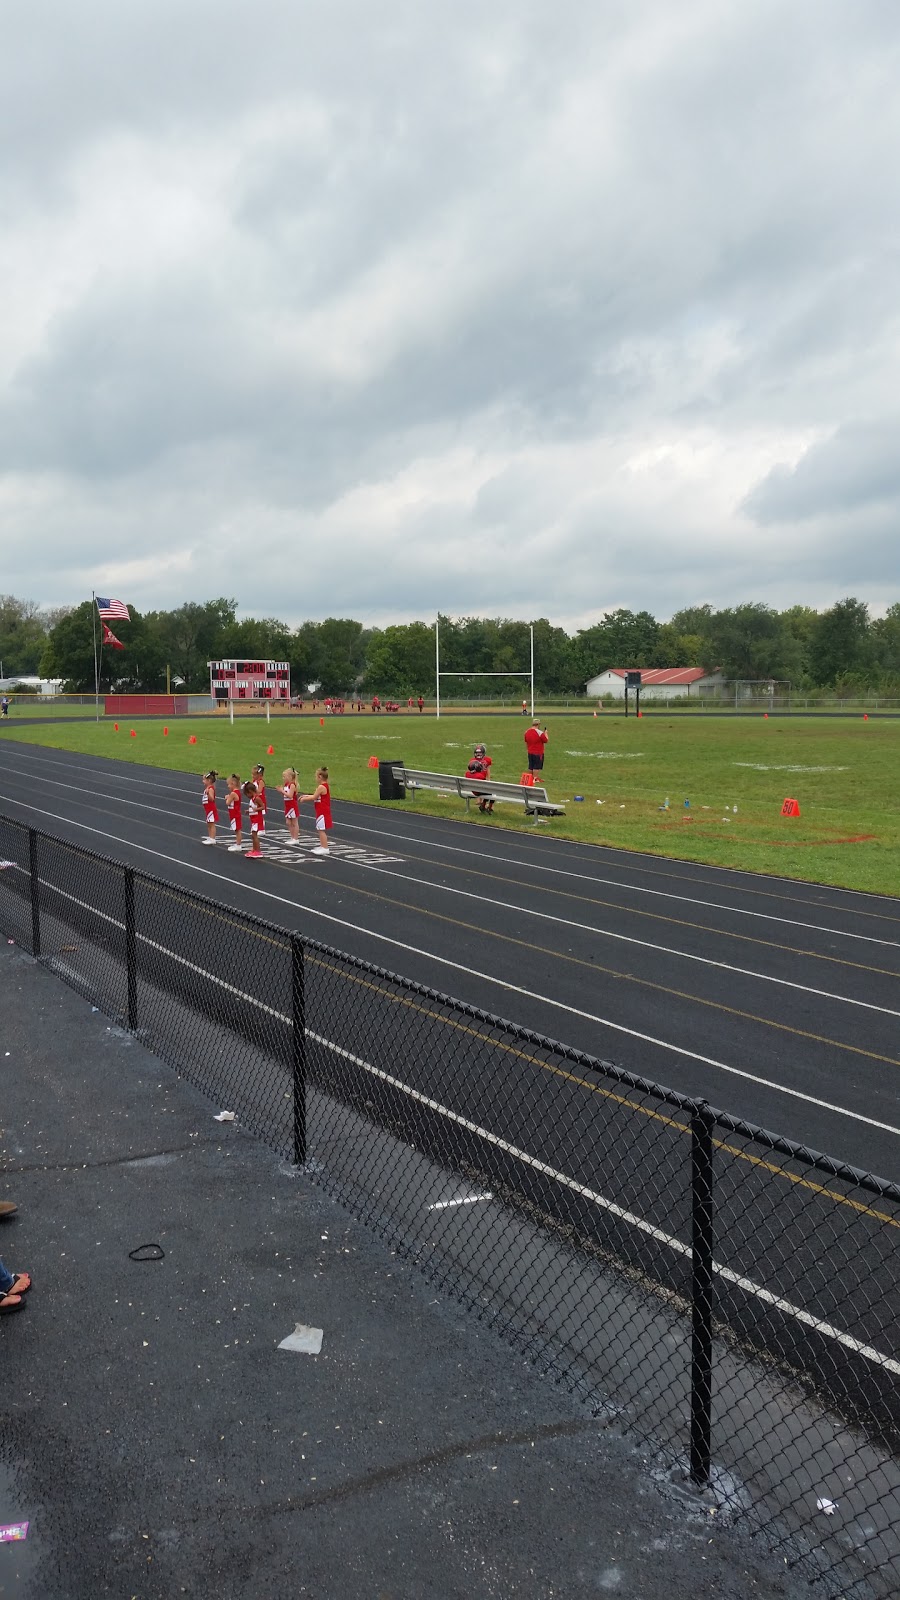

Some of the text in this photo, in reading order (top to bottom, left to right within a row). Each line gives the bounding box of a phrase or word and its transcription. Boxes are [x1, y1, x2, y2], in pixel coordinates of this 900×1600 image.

[215, 662, 232, 670] HOME
[243, 662, 265, 673] 2:00
[782, 800, 794, 815] 50
